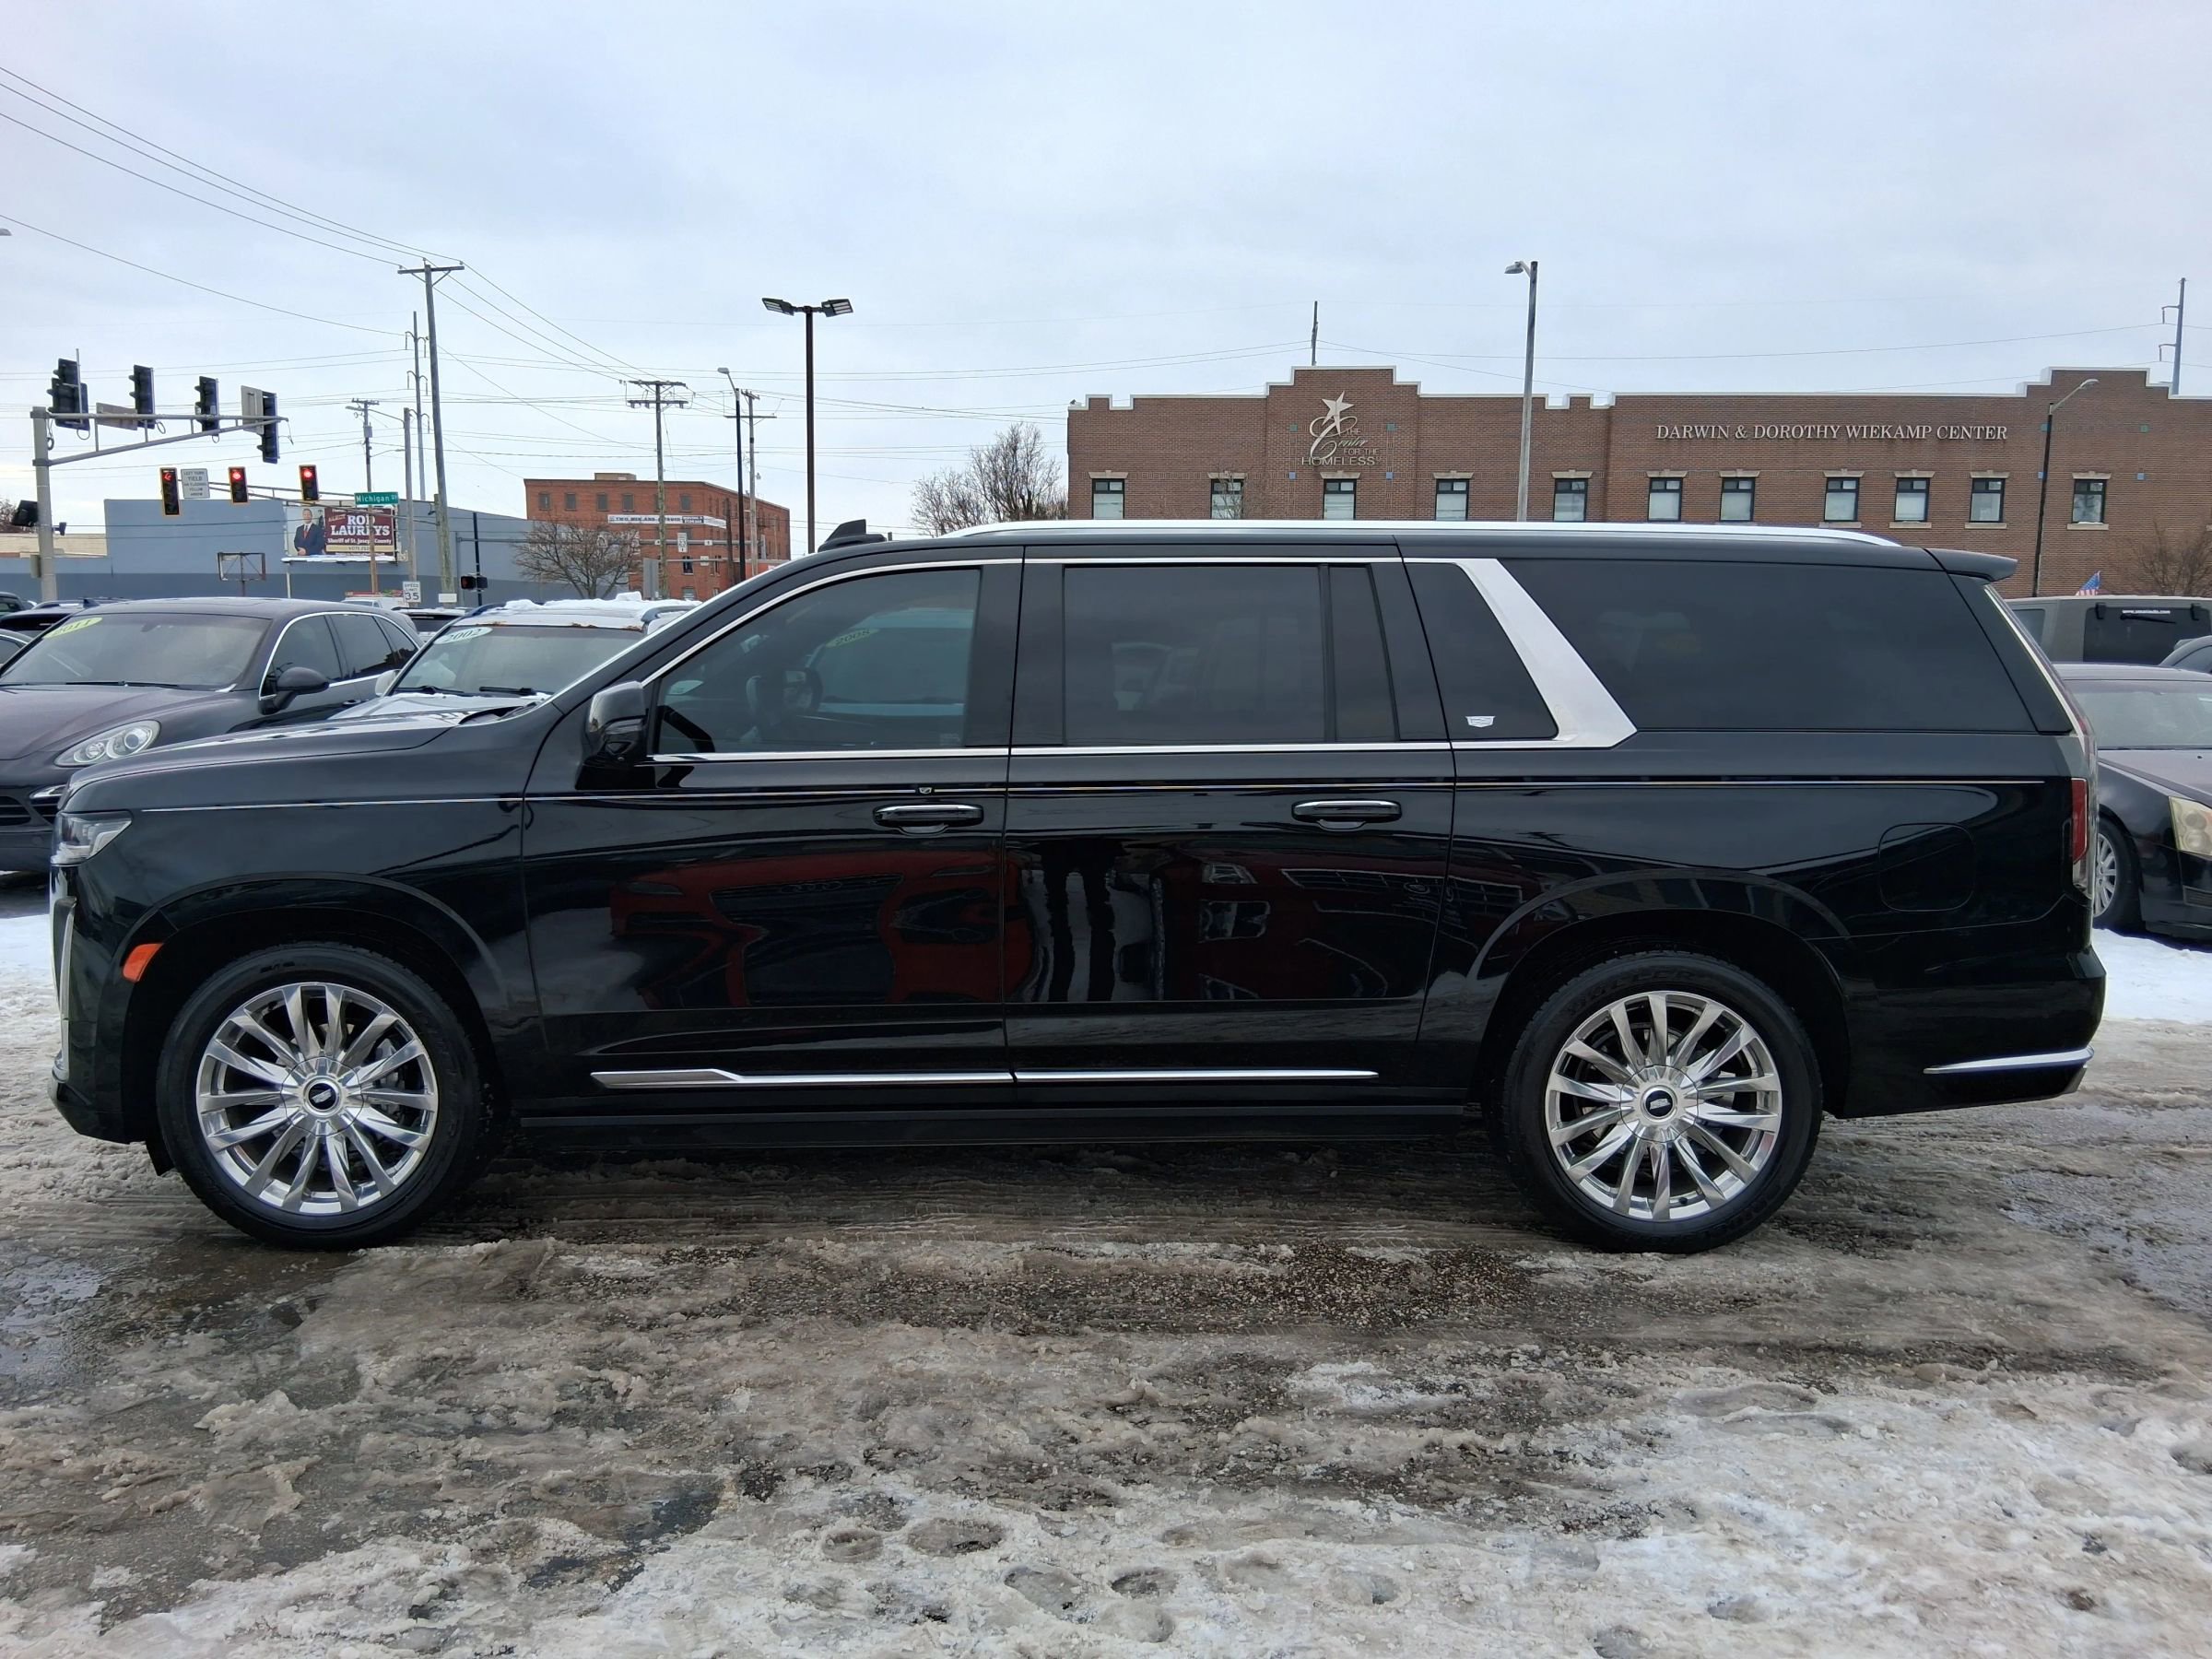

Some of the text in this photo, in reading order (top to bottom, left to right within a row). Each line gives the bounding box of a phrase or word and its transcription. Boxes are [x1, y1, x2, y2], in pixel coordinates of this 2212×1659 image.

[1656, 424, 2007, 440] DARWIN & DOROTHY WIEKAMP CENTER
[1301, 456, 1376, 466] HOMELESS
[356, 494, 390, 503] Michigan
[405, 592, 419, 600] 35
[443, 628, 482, 642] 2002
